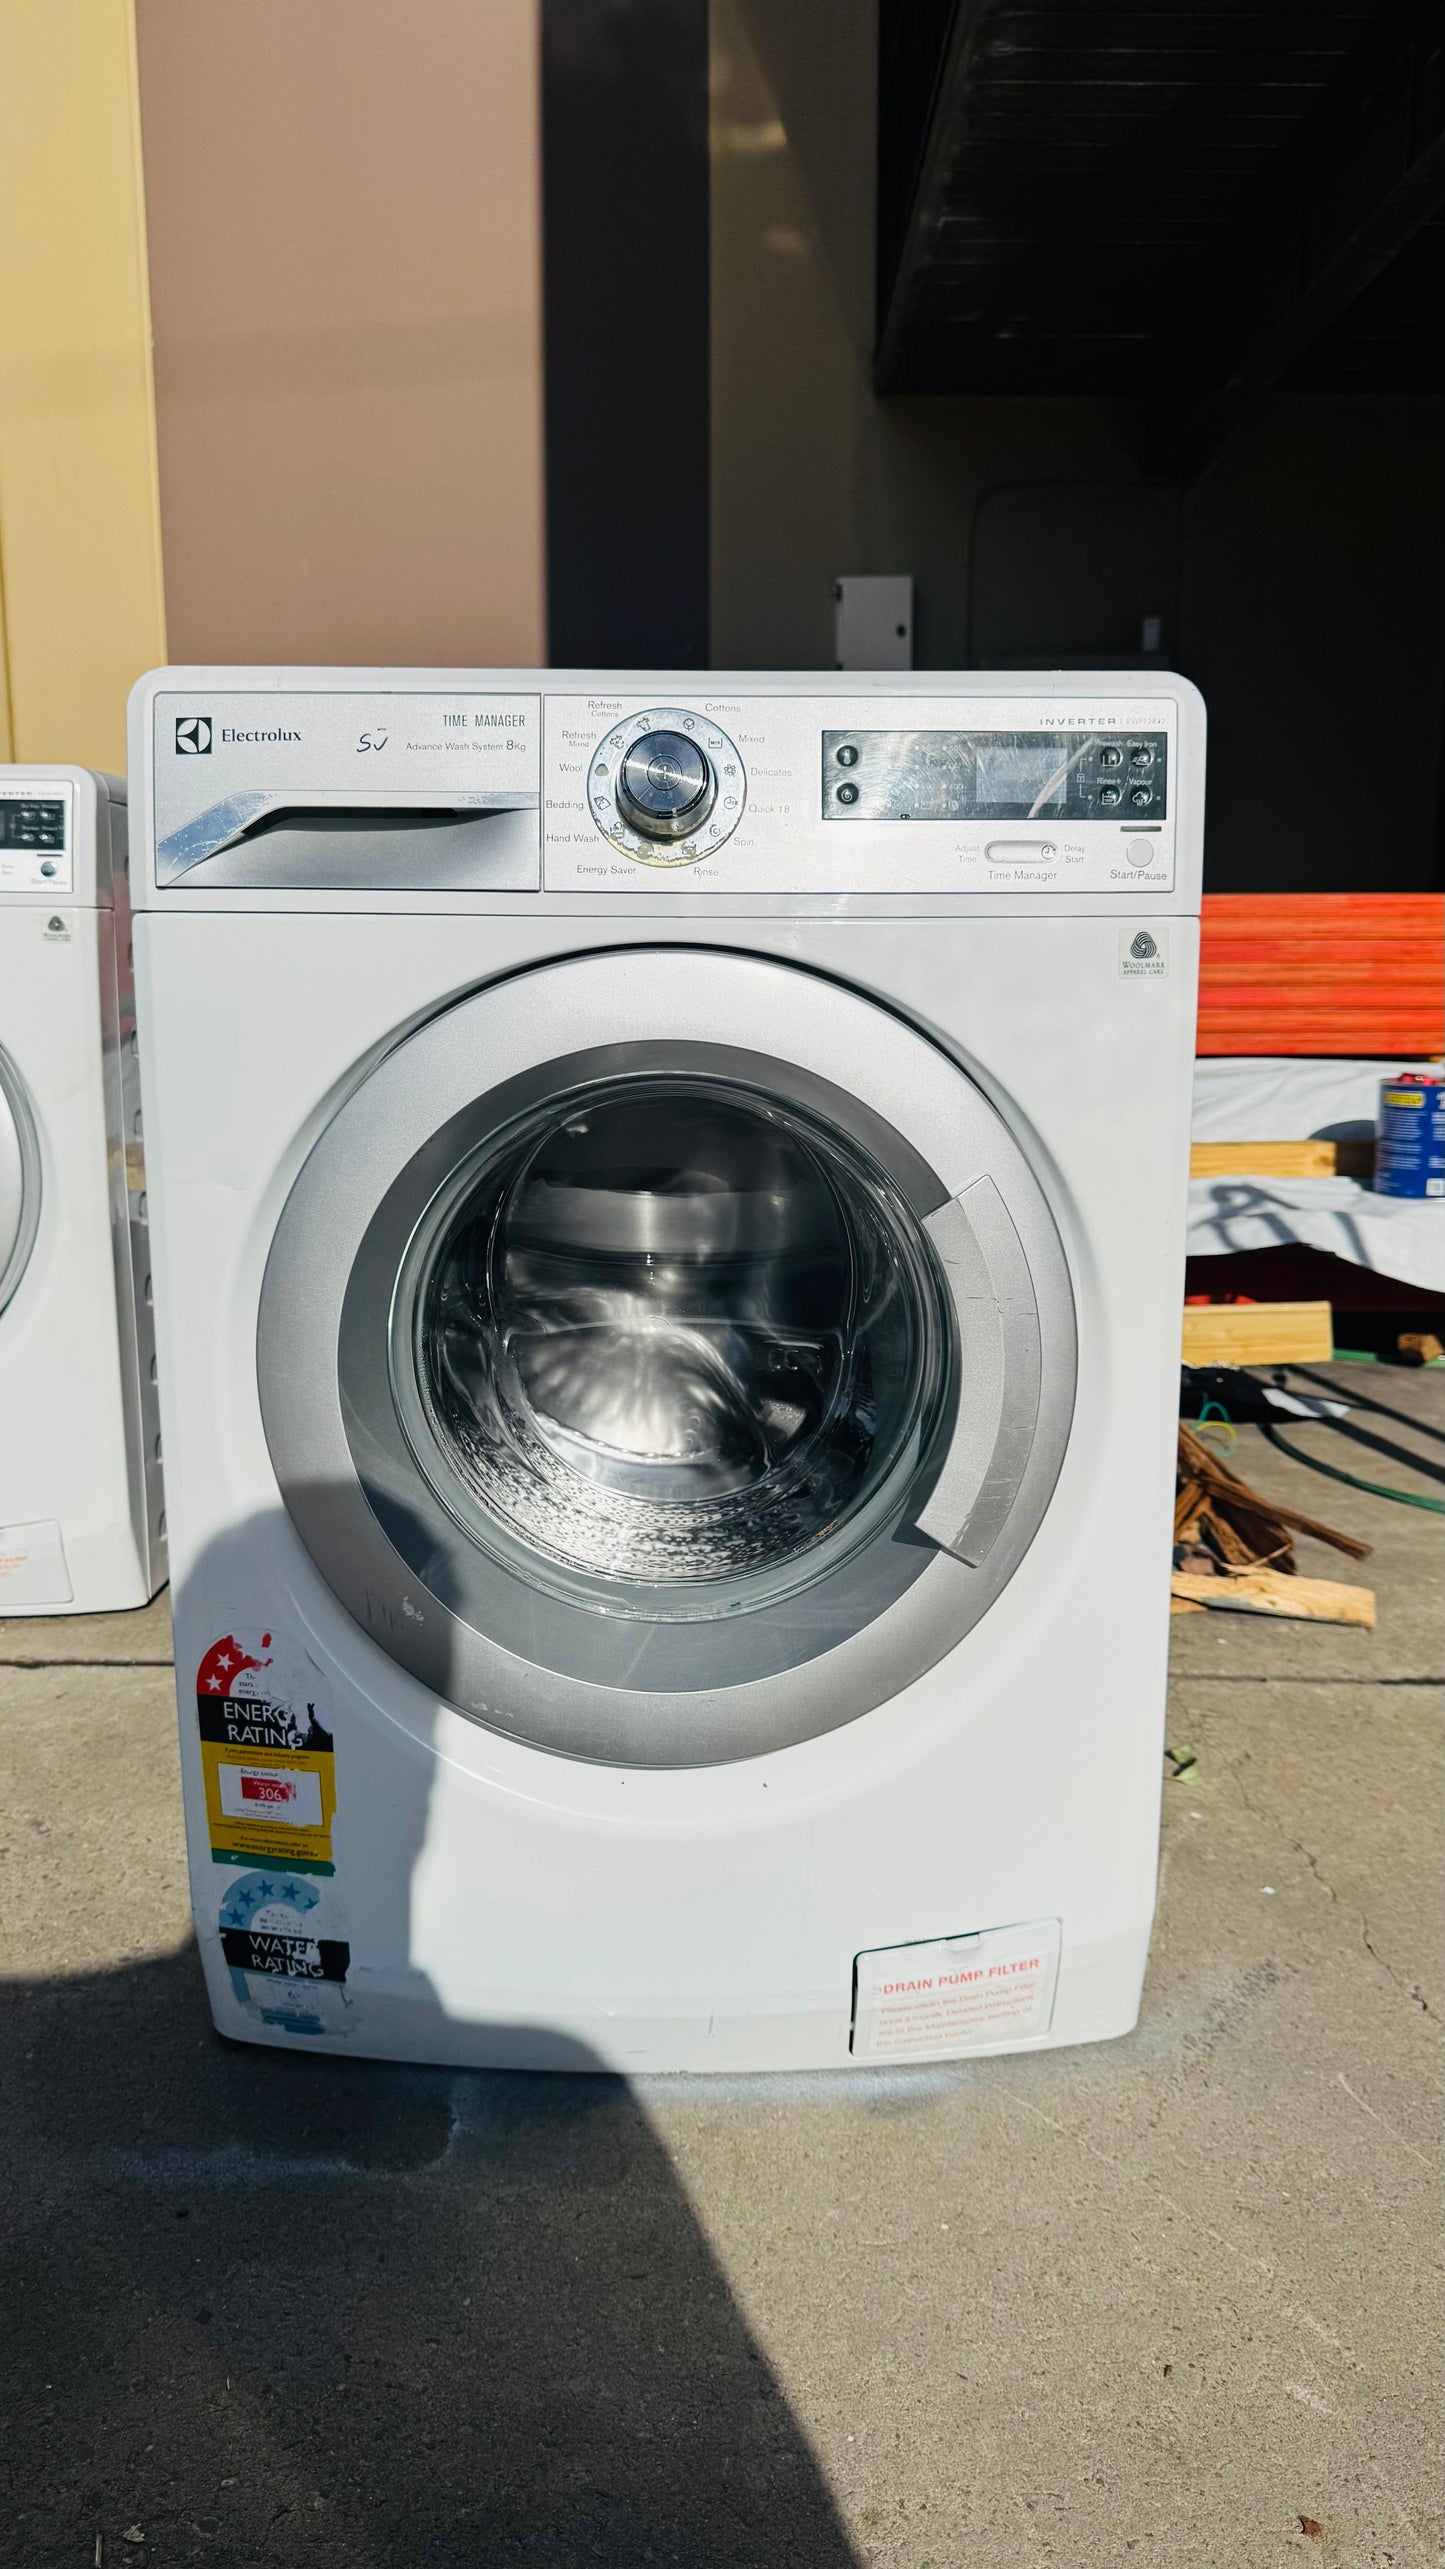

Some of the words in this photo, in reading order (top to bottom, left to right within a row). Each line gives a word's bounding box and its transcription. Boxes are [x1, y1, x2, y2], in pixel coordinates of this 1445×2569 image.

[587, 700, 623, 710] Refresh
[704, 703, 742, 713] Cottons
[443, 714, 468, 728] TIME
[475, 714, 526, 728] MANAGER
[221, 727, 302, 743] Electrolux
[561, 731, 597, 740] Refresh
[738, 734, 765, 744] Mixed
[406, 741, 443, 752] Advance
[445, 741, 469, 752] Wash
[471, 741, 504, 754] System
[506, 739, 527, 753] 8Kg
[1127, 740, 1144, 749] Easy
[1144, 740, 1158, 748] Iron
[559, 763, 583, 772] Wool
[751, 767, 792, 777] Delicates
[545, 800, 584, 811] Bedding
[748, 804, 775, 813] Quick
[778, 804, 790, 813] 18
[546, 834, 571, 843] Hand
[573, 834, 600, 843] Wash
[733, 837, 755, 847] Spin
[1065, 855, 1085, 864] Start
[576, 865, 608, 876] Energy
[610, 865, 637, 875] Saver
[693, 867, 719, 877] Rinse
[1109, 870, 1168, 881] Start/Pause
[988, 870, 1011, 880] Time
[1014, 870, 1058, 882] Manager
[1122, 961, 1165, 969] WOOLMARK
[223, 1701, 296, 1729] ENERG
[227, 1724, 303, 1749] RATING
[258, 1787, 282, 1800] 306
[251, 1954, 324, 1977] RATING
[883, 1979, 932, 1994] DRAIN
[938, 1970, 983, 1987] PUMP
[988, 1958, 1040, 1979] FILTER
